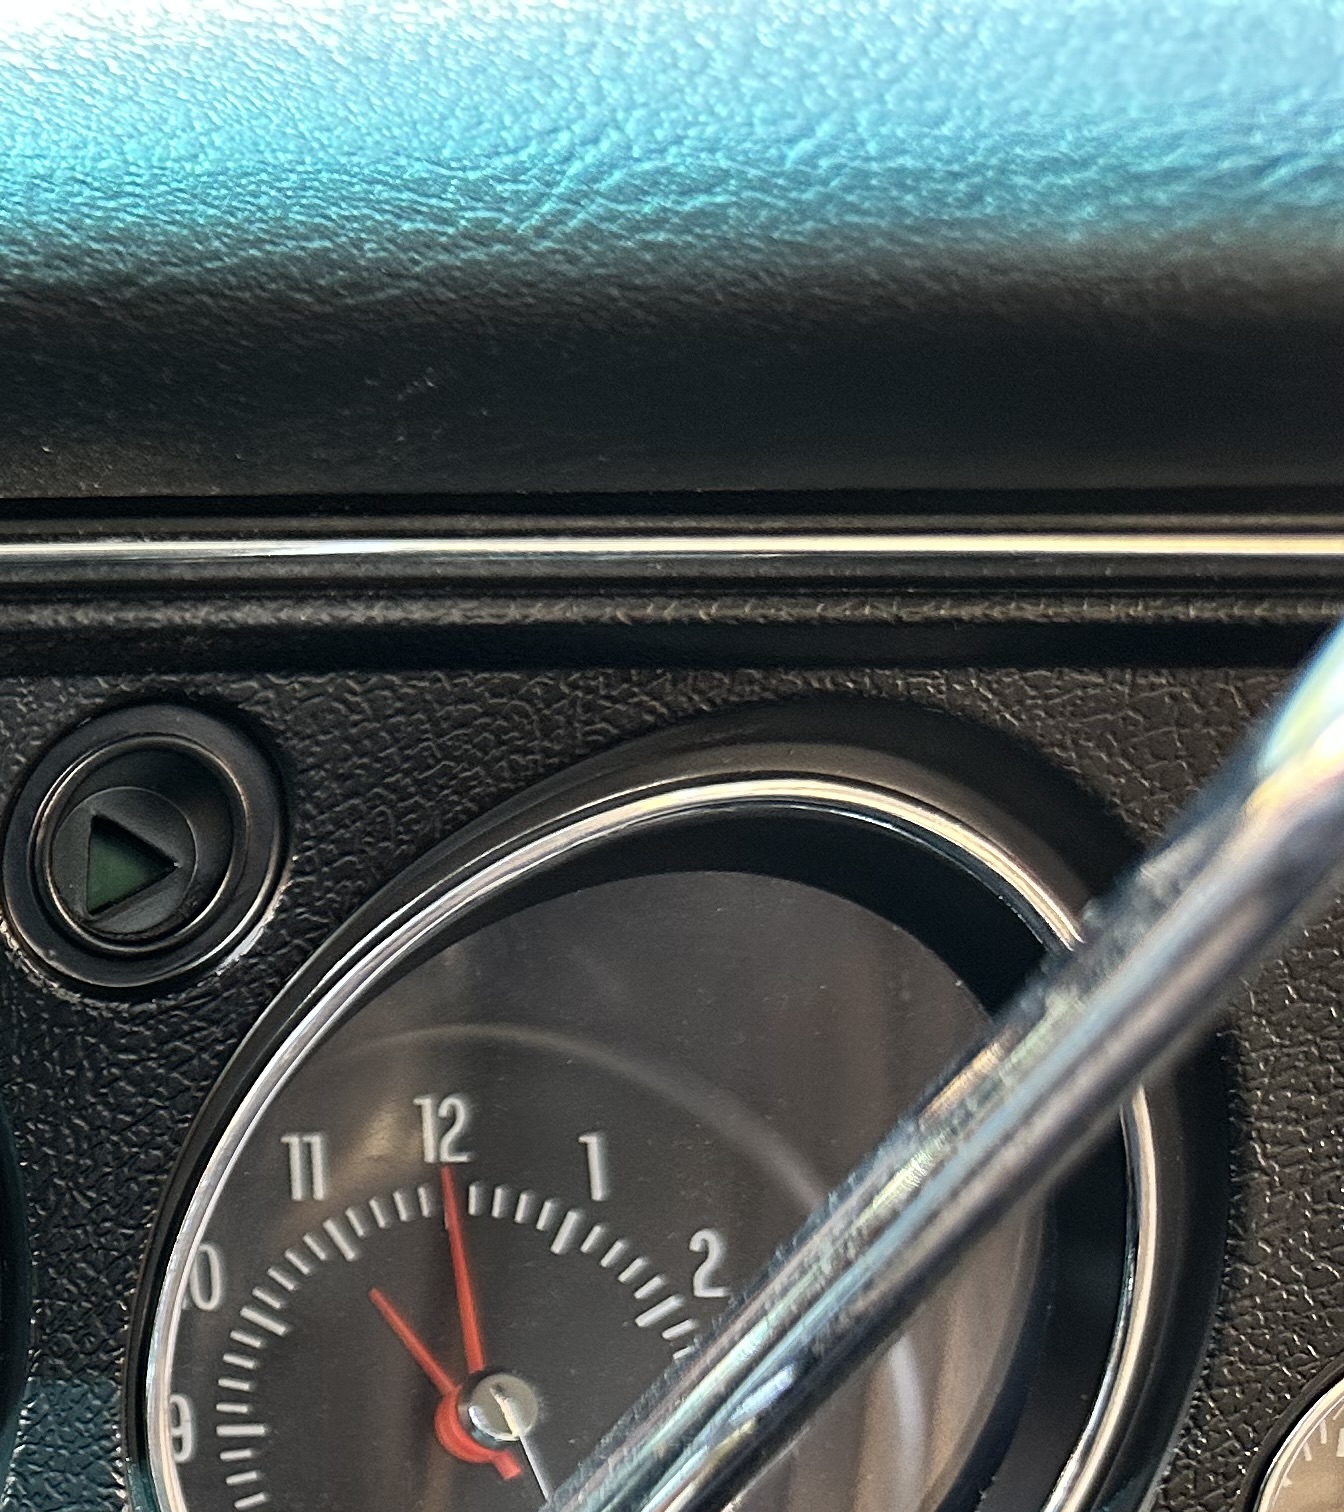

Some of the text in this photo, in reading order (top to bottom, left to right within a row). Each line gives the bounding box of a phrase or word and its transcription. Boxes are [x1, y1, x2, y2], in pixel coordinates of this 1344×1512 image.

[413, 1097, 473, 1163] 12
[281, 1133, 328, 1200] 11
[579, 1134, 611, 1200] 1
[688, 1230, 727, 1298] 2
